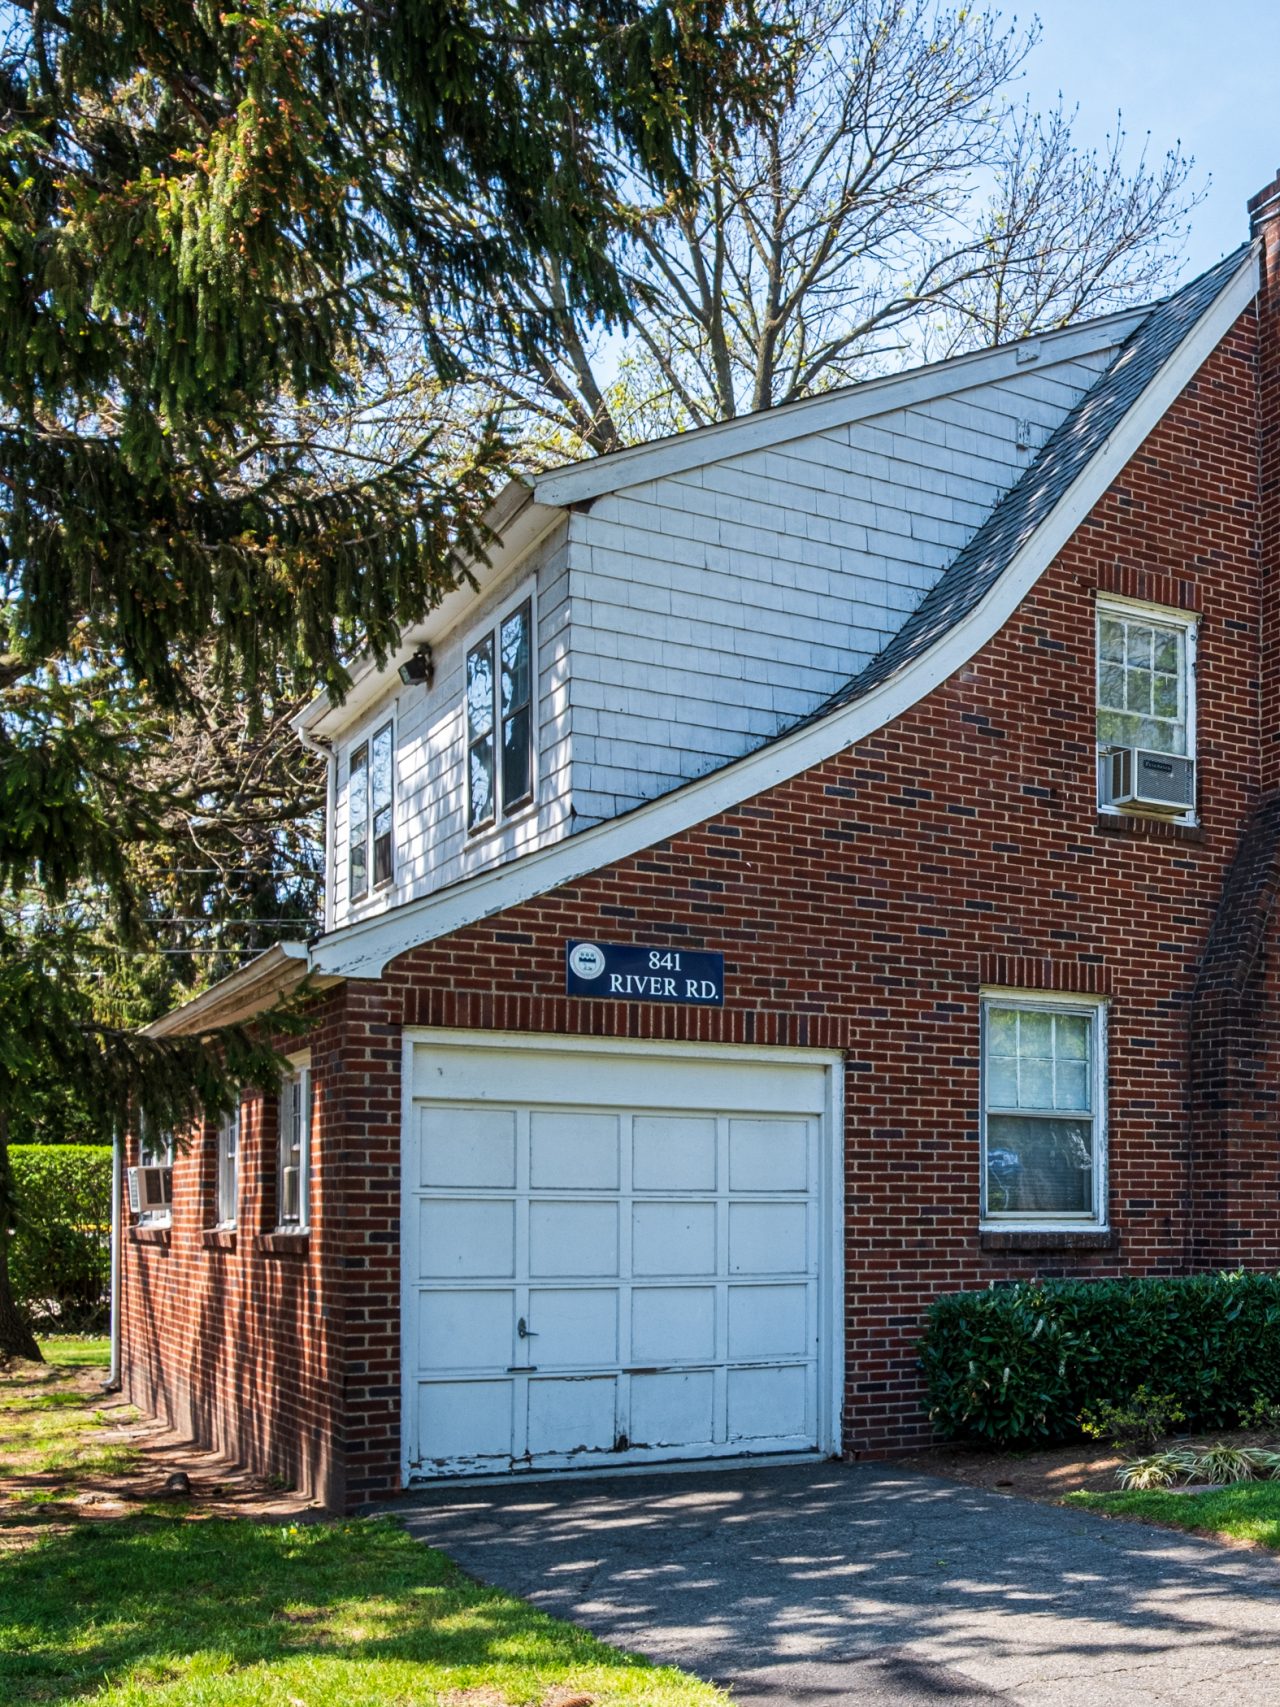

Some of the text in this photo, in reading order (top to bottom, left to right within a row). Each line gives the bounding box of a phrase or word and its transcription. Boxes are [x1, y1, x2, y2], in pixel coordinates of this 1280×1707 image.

[649, 951, 682, 972] 841
[609, 973, 719, 999] RIVER RD.
